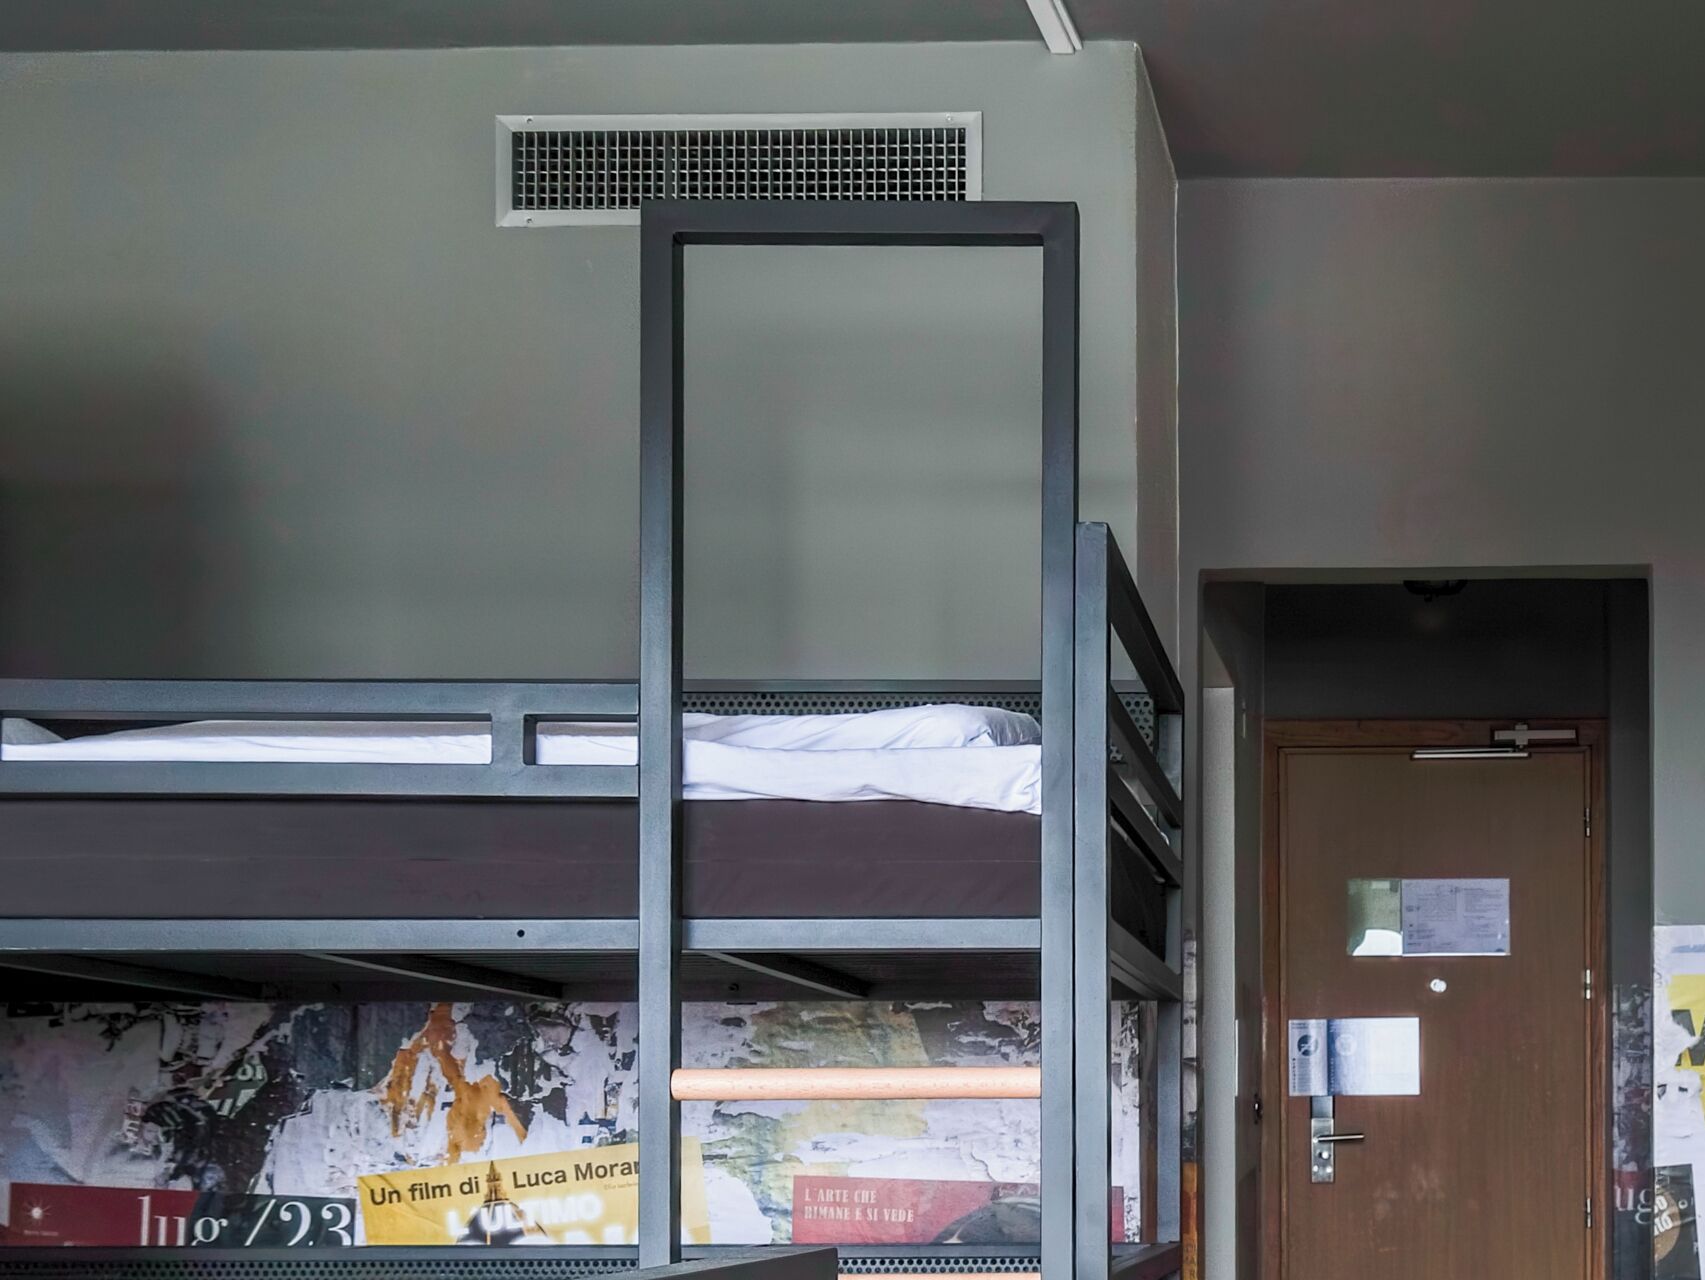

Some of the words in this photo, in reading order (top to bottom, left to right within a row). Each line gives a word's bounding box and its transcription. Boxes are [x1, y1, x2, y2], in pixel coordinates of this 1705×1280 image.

[370, 1188, 401, 1206] Un
[408, 1181, 452, 1201] film
[459, 1176, 479, 1195] di
[512, 1170, 566, 1189] Luca
[854, 1190, 877, 1204] CHE
[804, 1205, 850, 1220] RIMANE
[855, 1207, 863, 1221] E
[866, 1207, 879, 1221] SI
[883, 1208, 914, 1222] VEDE
